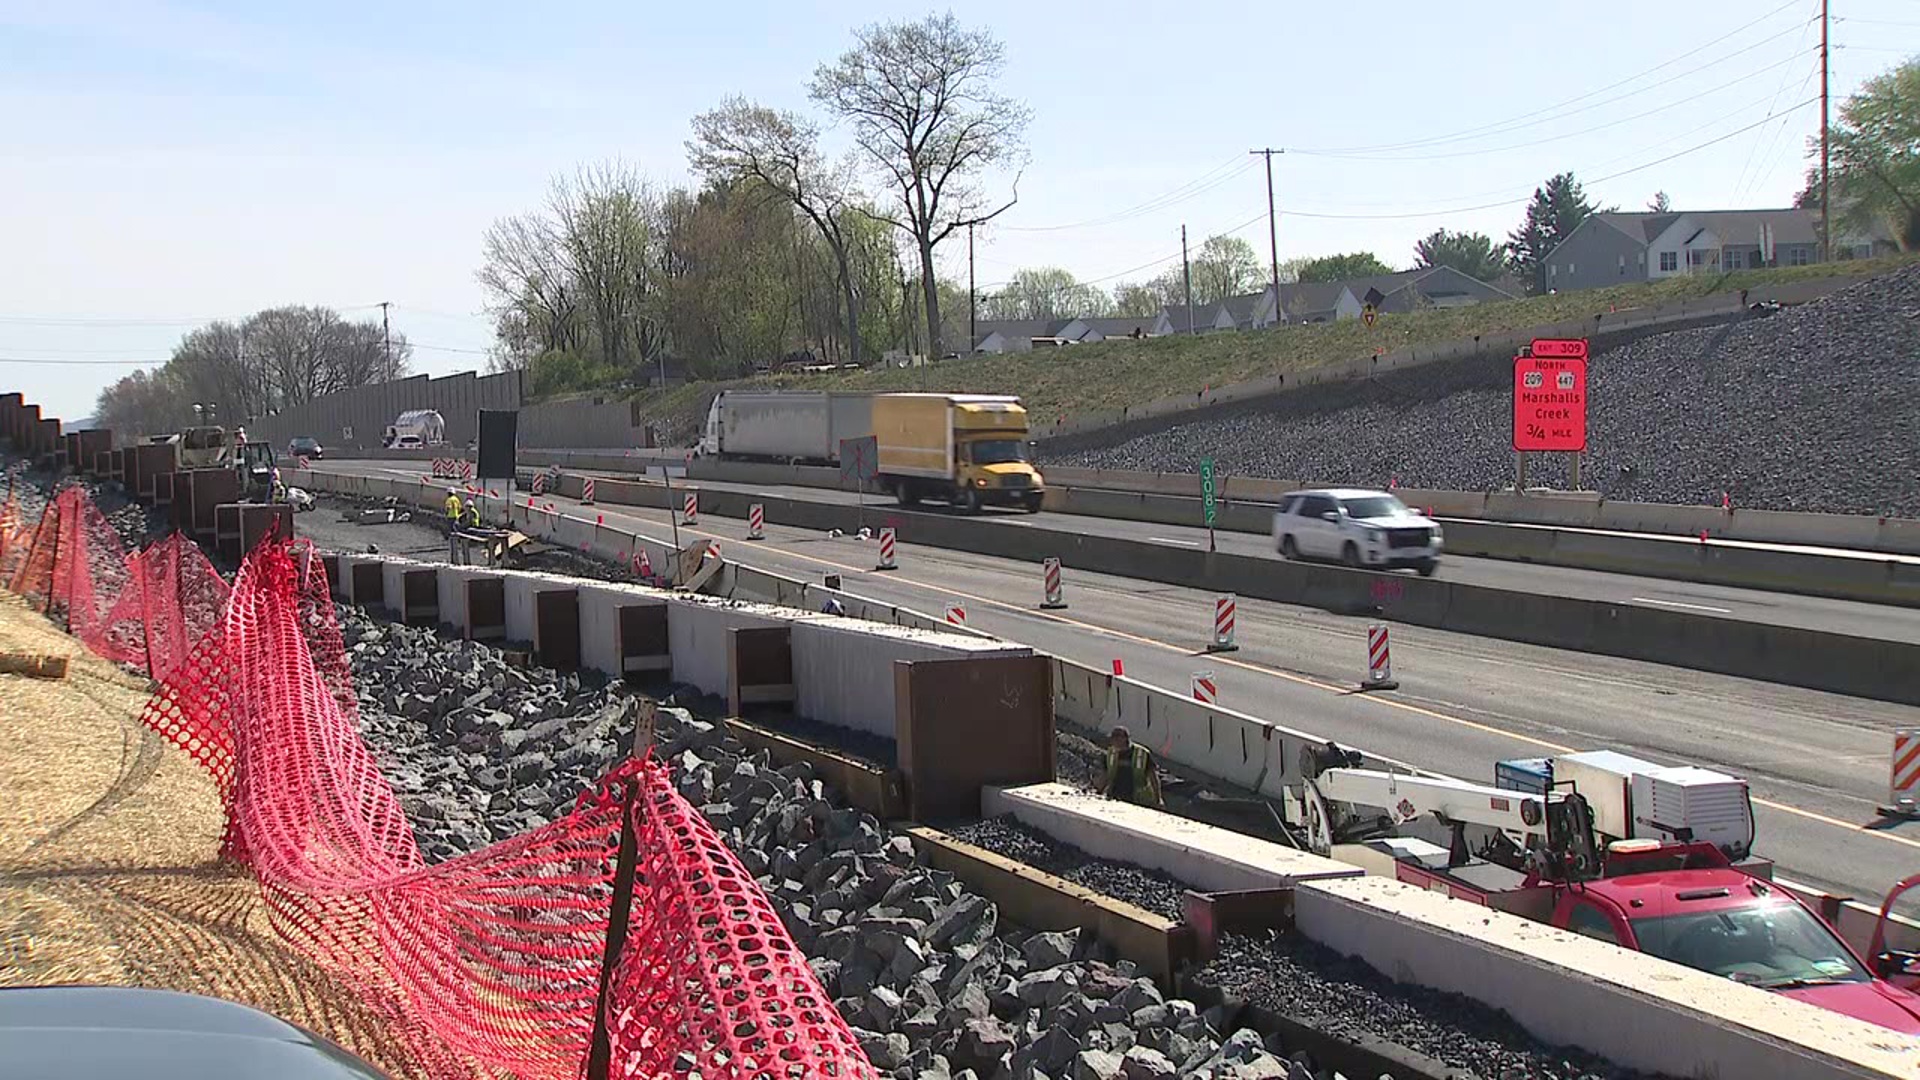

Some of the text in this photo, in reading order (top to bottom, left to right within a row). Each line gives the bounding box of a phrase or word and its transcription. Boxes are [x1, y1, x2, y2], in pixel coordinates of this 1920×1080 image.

[1561, 343, 1581, 353] 309
[1524, 374, 1542, 385] 209
[1558, 376, 1573, 385] 447
[1522, 392, 1580, 404] Marshalls
[1535, 408, 1570, 419] Creek
[1526, 424, 1572, 440] 3/4 MILE
